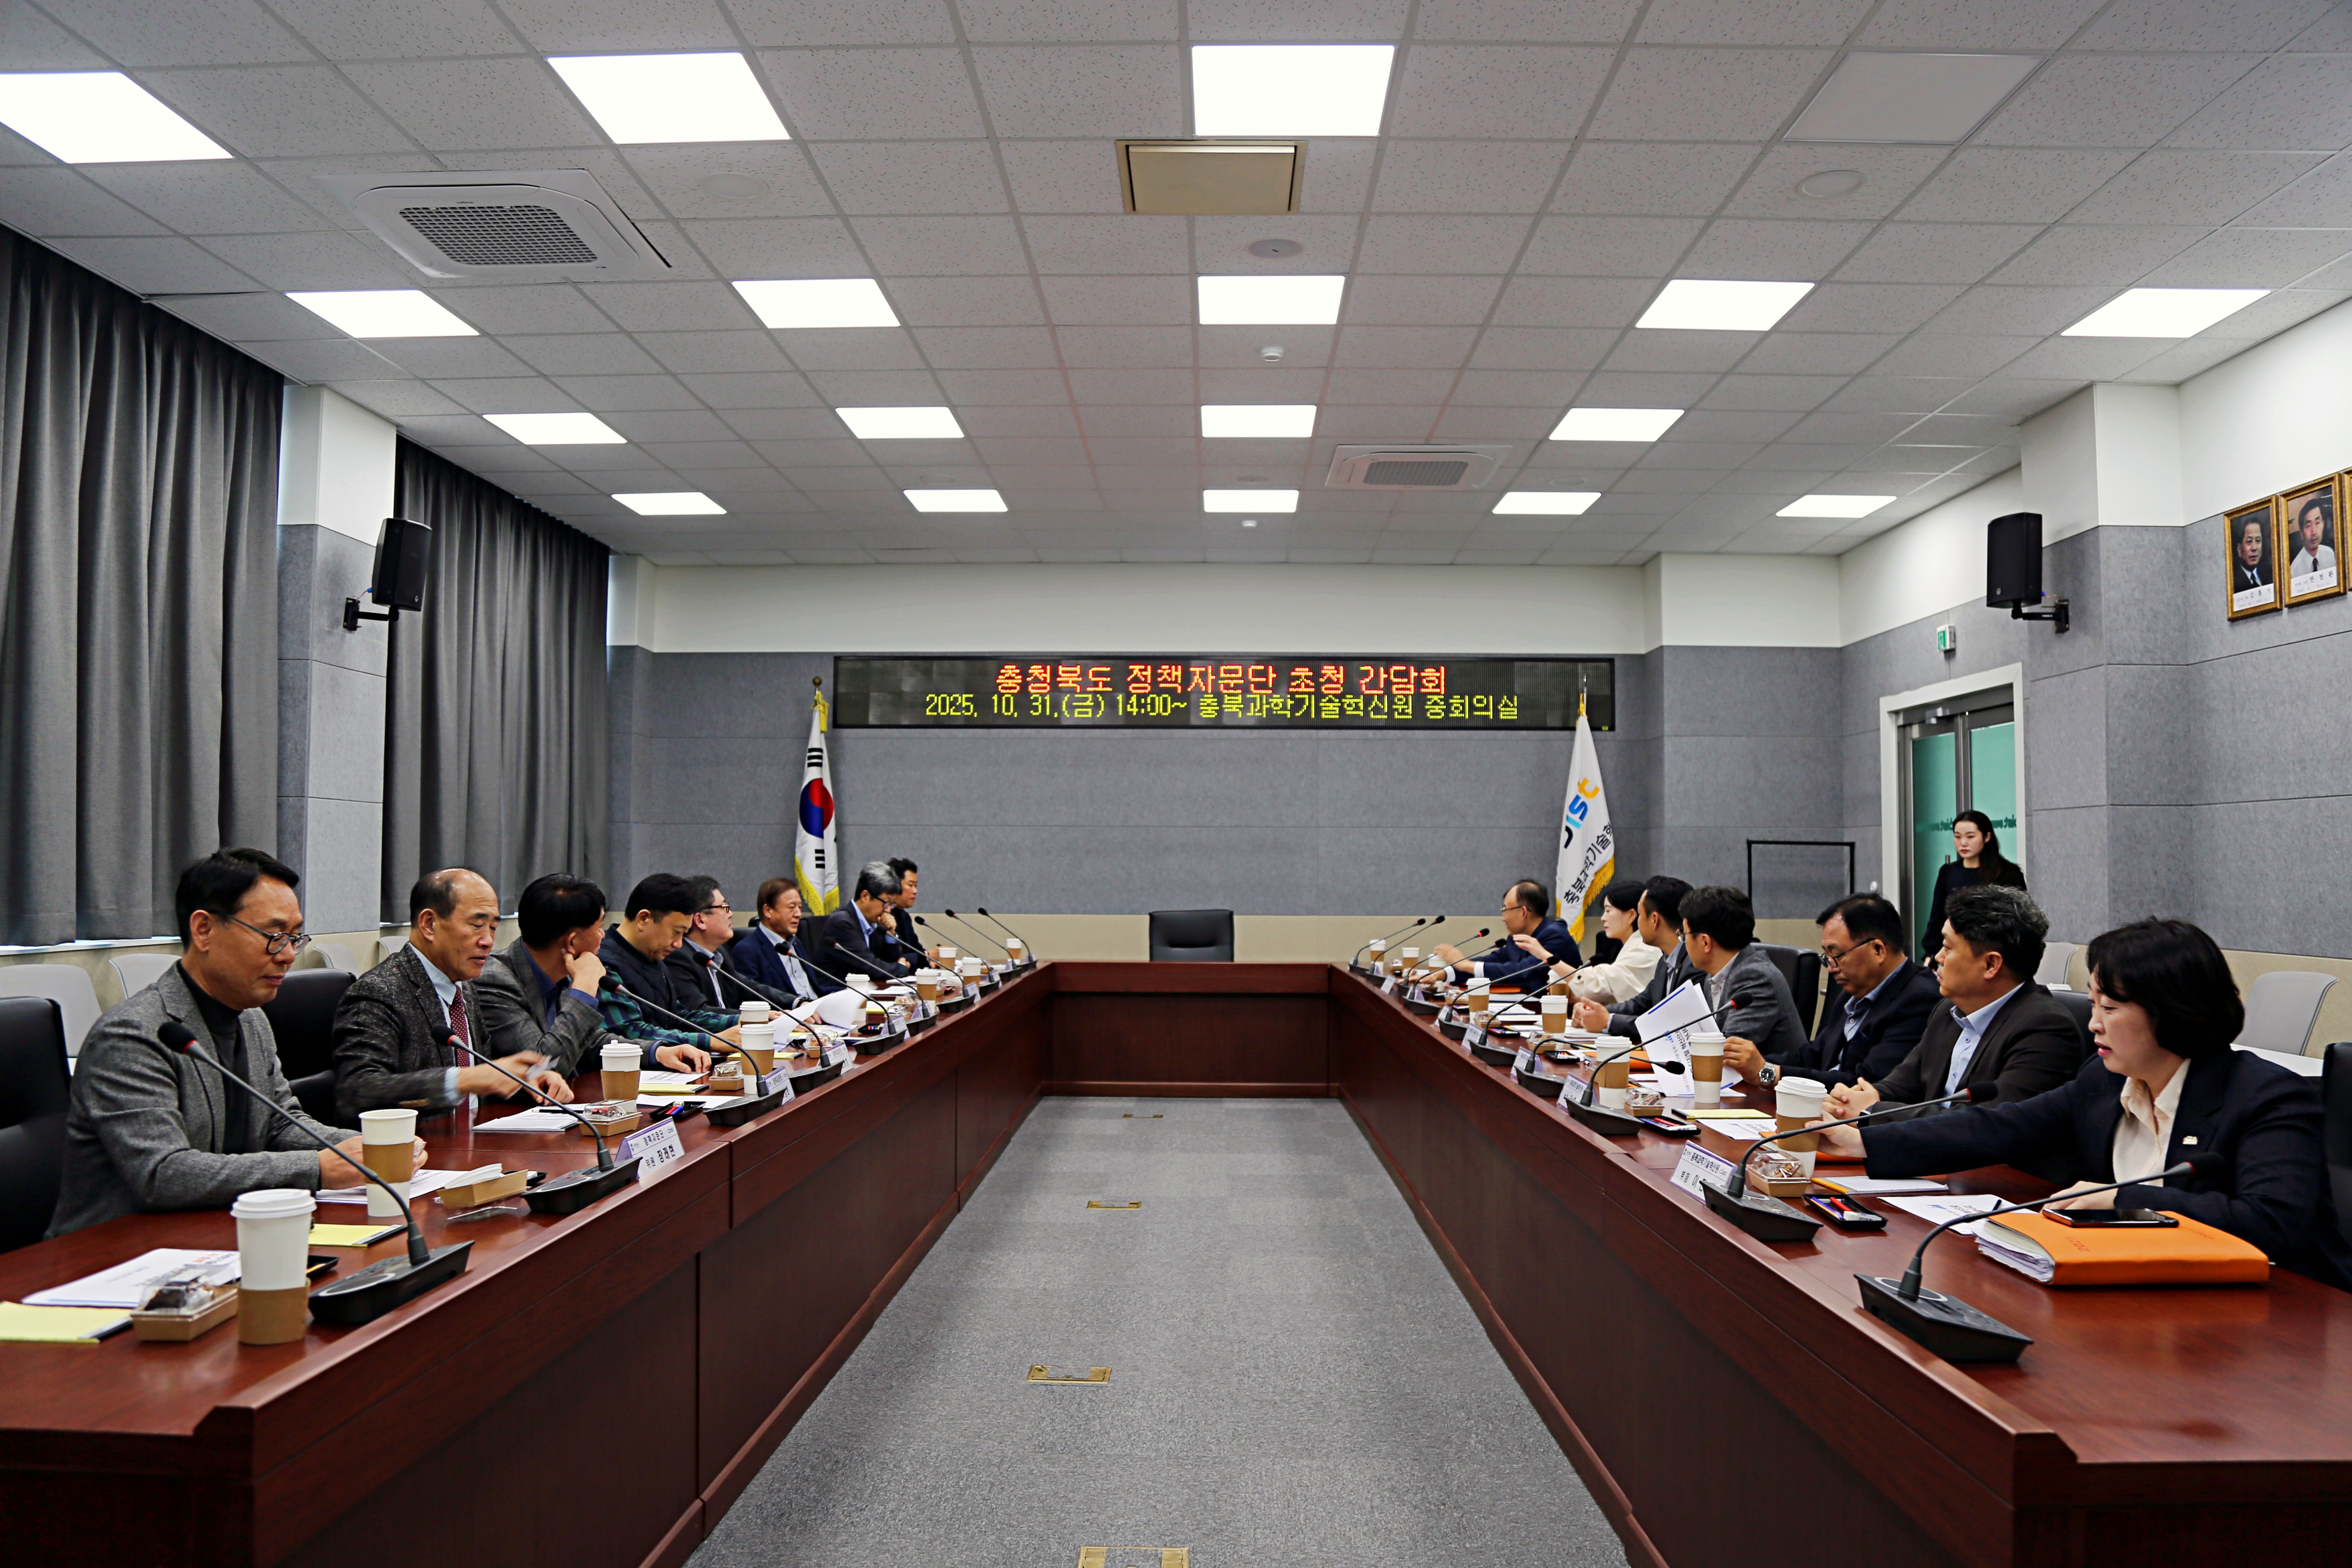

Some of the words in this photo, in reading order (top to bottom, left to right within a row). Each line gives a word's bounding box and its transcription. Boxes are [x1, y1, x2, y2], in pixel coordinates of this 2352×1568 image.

[996, 664, 1112, 693] 충청북도
[1127, 664, 1277, 694] 정책자문단
[1288, 665, 1344, 694] 초청
[1359, 665, 1446, 695] 간담회
[1117, 694, 1187, 715] 14:00~
[1200, 694, 1413, 719] 충북과학기술혁신원
[1424, 695, 1518, 719] 중회의실
[643, 1129, 664, 1146] 정책자문단
[645, 1156, 656, 1169] 위원
